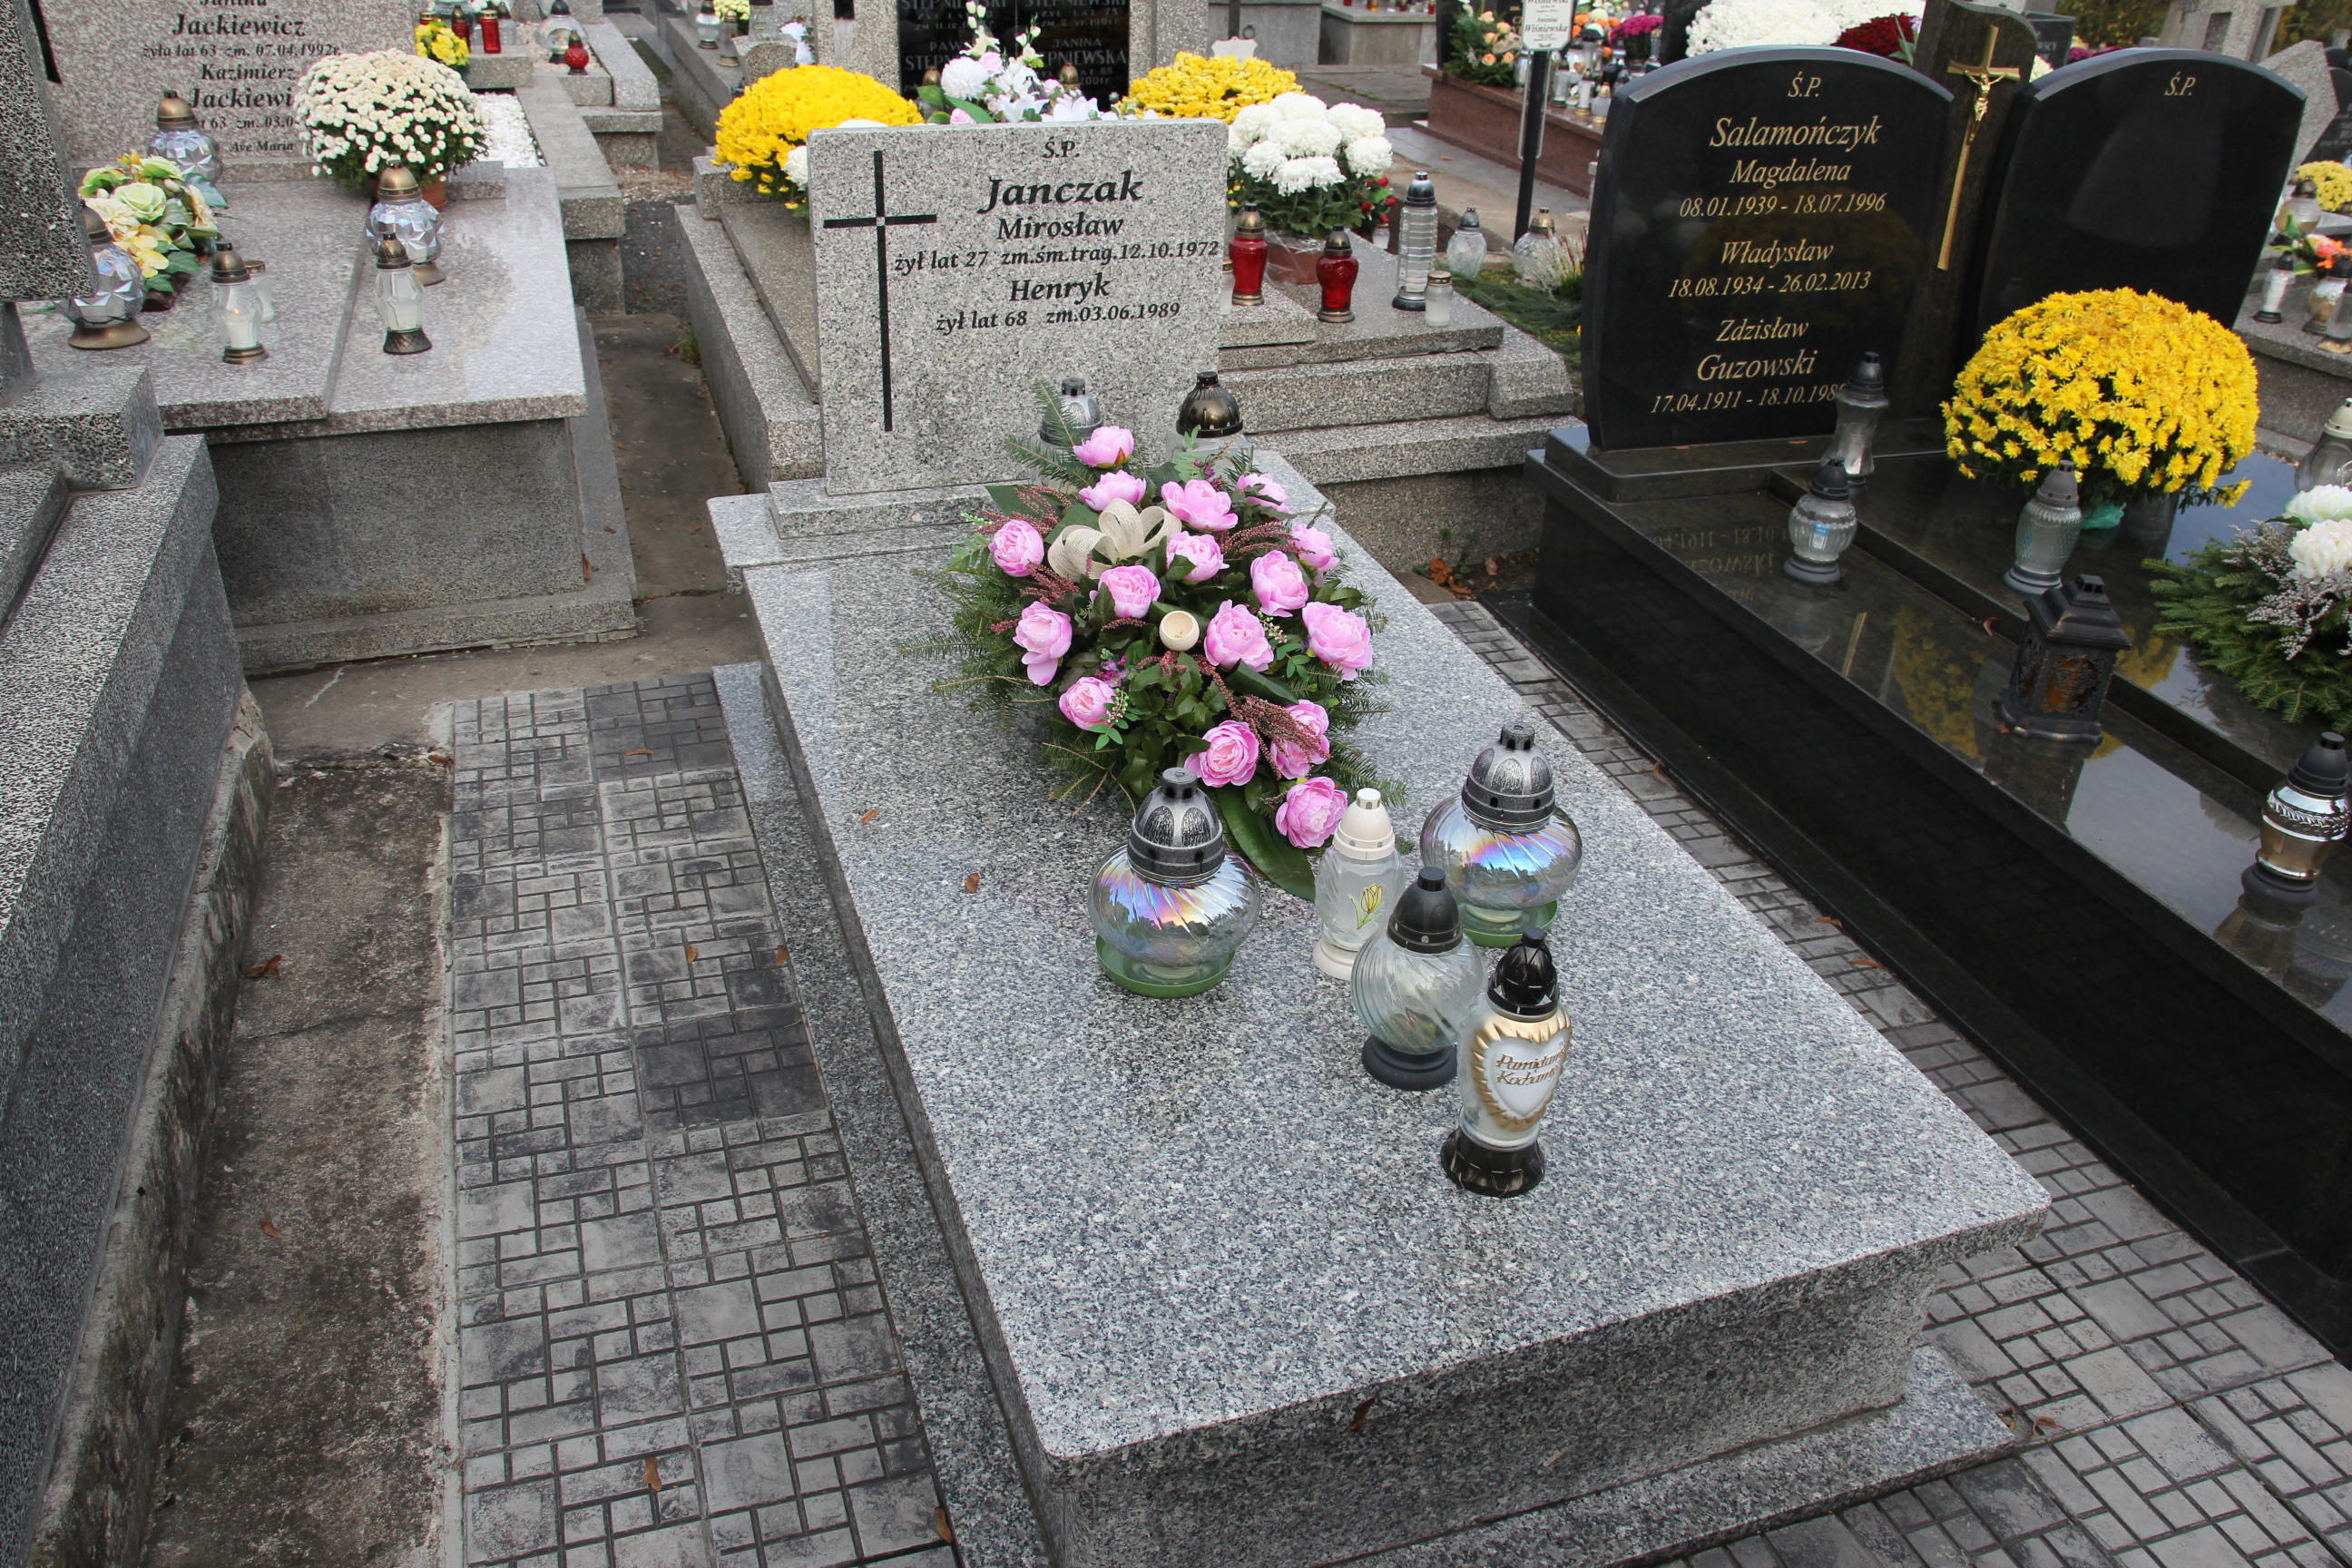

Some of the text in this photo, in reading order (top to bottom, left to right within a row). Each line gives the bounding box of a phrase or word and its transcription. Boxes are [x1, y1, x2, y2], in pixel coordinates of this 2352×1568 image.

[172, 14, 306, 36] Jackiewicz
[1525, 24, 1569, 33] Wiśniewska
[143, 45, 172, 57] żyła
[176, 45, 196, 56] lat
[201, 44, 217, 56] 63
[227, 47, 250, 56] zm.
[1053, 38, 1102, 48] JANINA
[1043, 50, 1127, 66] PNIEWSKA
[201, 64, 296, 80] Kazimierz
[1788, 72, 1821, 97] Ś.P.
[2164, 71, 2197, 95] Ś.P.
[190, 87, 293, 109] Jackiewi
[1710, 115, 1883, 152] Salamończyk
[230, 141, 294, 152] Ave Maria
[1044, 136, 1080, 159] Ś.P.
[1729, 158, 1852, 189] Magdalena
[977, 170, 1142, 214] Janczak
[1680, 196, 1778, 217] 08.01.1939
[1793, 192, 1887, 214] 18.07.1996
[997, 211, 1123, 240] Mirosław
[895, 250, 926, 275] żył
[930, 250, 958, 270] lat
[965, 250, 989, 268] 27
[1720, 239, 1834, 269] Władysław
[1009, 272, 1111, 304] Henryk
[1668, 276, 1765, 298] 18.08.1934
[1779, 271, 1871, 293] 26.02.2013
[936, 311, 967, 336] żył
[971, 311, 997, 329] lat
[1004, 310, 1028, 327] 68
[1716, 317, 1809, 342] Zdzisław
[1697, 348, 1818, 381] Guzowski
[1651, 390, 1742, 414] 17.04.1911
